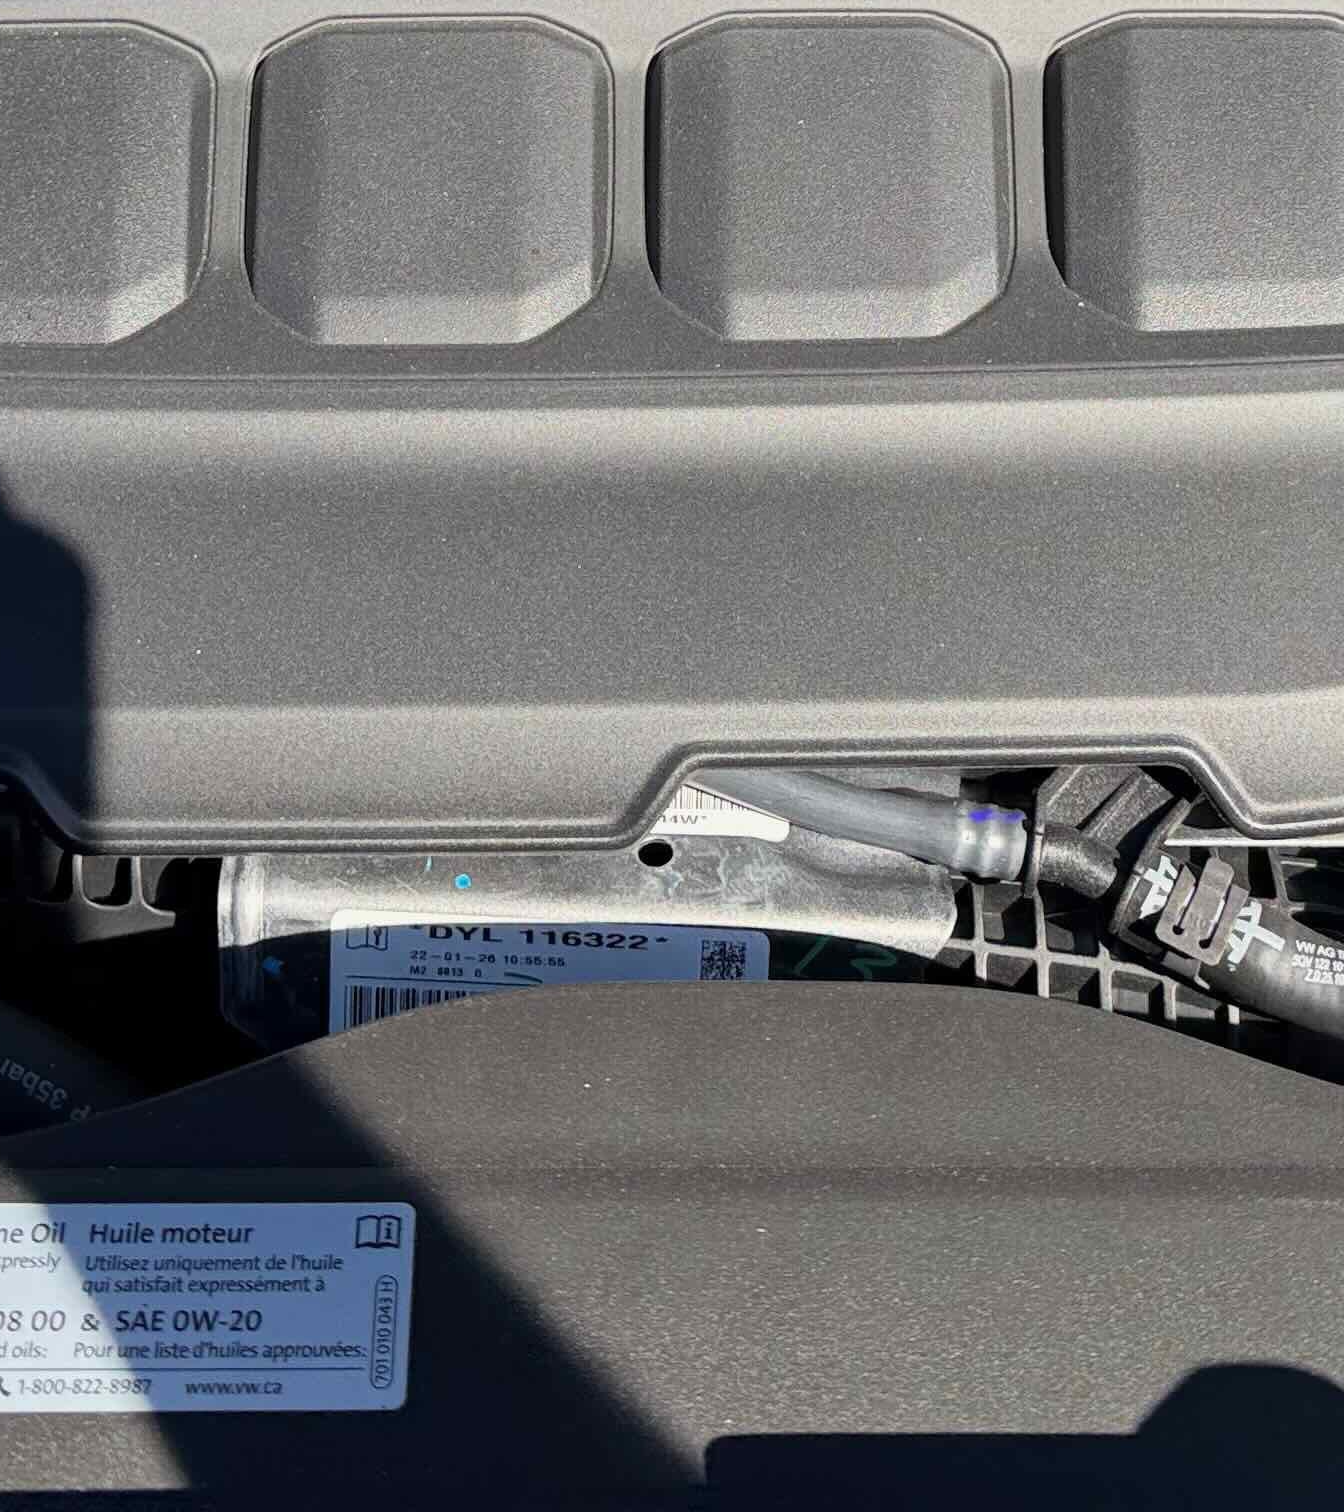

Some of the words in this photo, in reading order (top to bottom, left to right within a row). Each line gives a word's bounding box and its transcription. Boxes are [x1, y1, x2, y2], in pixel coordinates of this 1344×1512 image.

[1296, 940, 1316, 955] VW
[1317, 945, 1336, 959] AG
[31, 1221, 66, 1244] Oil
[89, 1222, 154, 1244] Huile
[160, 1225, 254, 1244] moteur
[85, 1255, 149, 1271] Utilisez
[154, 1256, 261, 1276] uniquement
[265, 1255, 287, 1271] de
[290, 1255, 344, 1271] l'huile
[82, 1277, 109, 1296] qui
[113, 1276, 182, 1293] satisfait
[314, 1277, 325, 1293] à
[379, 1280, 393, 1292] H
[31, 1310, 66, 1332] 00
[80, 1313, 100, 1332] &
[116, 1310, 164, 1332] SAE
[172, 1309, 262, 1332] 0W-20
[11, 1341, 48, 1359] oils:
[74, 1342, 113, 1359] Pour
[116, 1345, 149, 1358] une
[154, 1341, 187, 1359] liste
[192, 1341, 259, 1359] d'huiles
[17, 1378, 152, 1395] 1-800-822-8987
[185, 1380, 283, 1395] www.vw.ca
